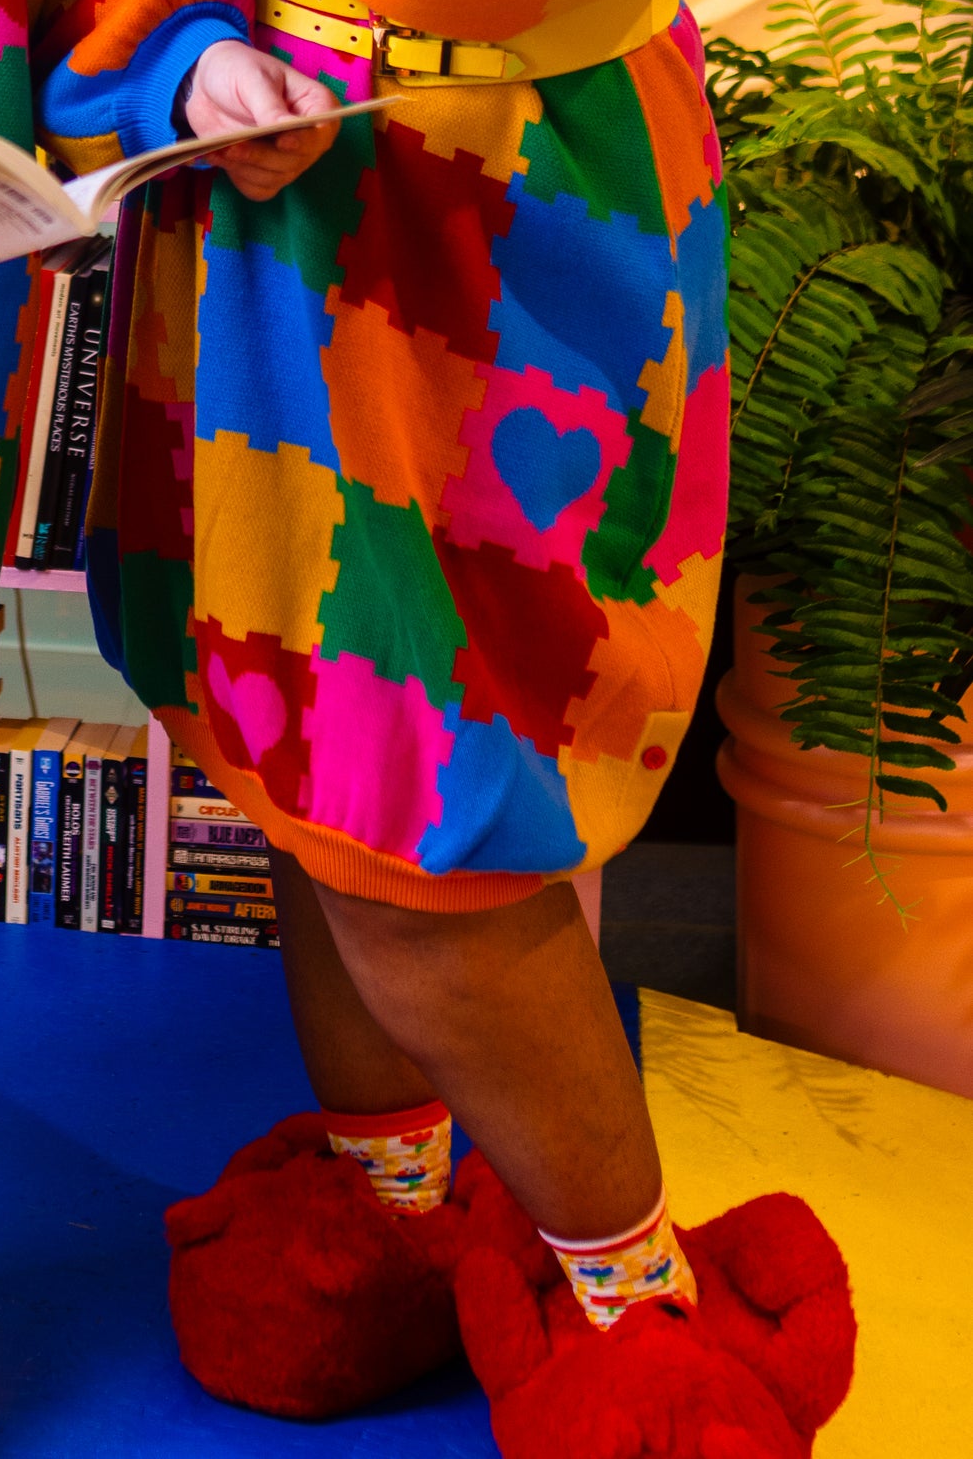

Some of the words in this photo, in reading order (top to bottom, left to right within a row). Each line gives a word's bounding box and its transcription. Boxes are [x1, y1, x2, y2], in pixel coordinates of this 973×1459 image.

[57, 282, 66, 308] modern
[50, 321, 61, 358] movements
[55, 345, 74, 413] MYSTERIOUS
[66, 327, 101, 458] UNIVERSE
[49, 412, 64, 452] PLACES
[67, 473, 76, 497] NICOLAS
[33, 780, 54, 815] GABRIEL'S
[87, 777, 97, 813] BETWEEN
[33, 816, 54, 839] GHOST
[71, 802, 81, 836] BOLOS
[87, 813, 96, 827] THE
[61, 829, 72, 859] KEITH
[86, 827, 95, 850] STARS
[208, 826, 231, 843] BLUE
[233, 828, 265, 846] ADEPT
[106, 845, 114, 870] RICK
[60, 860, 70, 902] LAUMER
[134, 876, 142, 898] LARRY
[209, 880, 267, 894] ARMAGEDDON
[134, 897, 142, 915] NIVEN
[191, 933, 223, 942] DAVID
[224, 934, 257, 944] DRAKE
[213, 925, 259, 936] STIRLING
